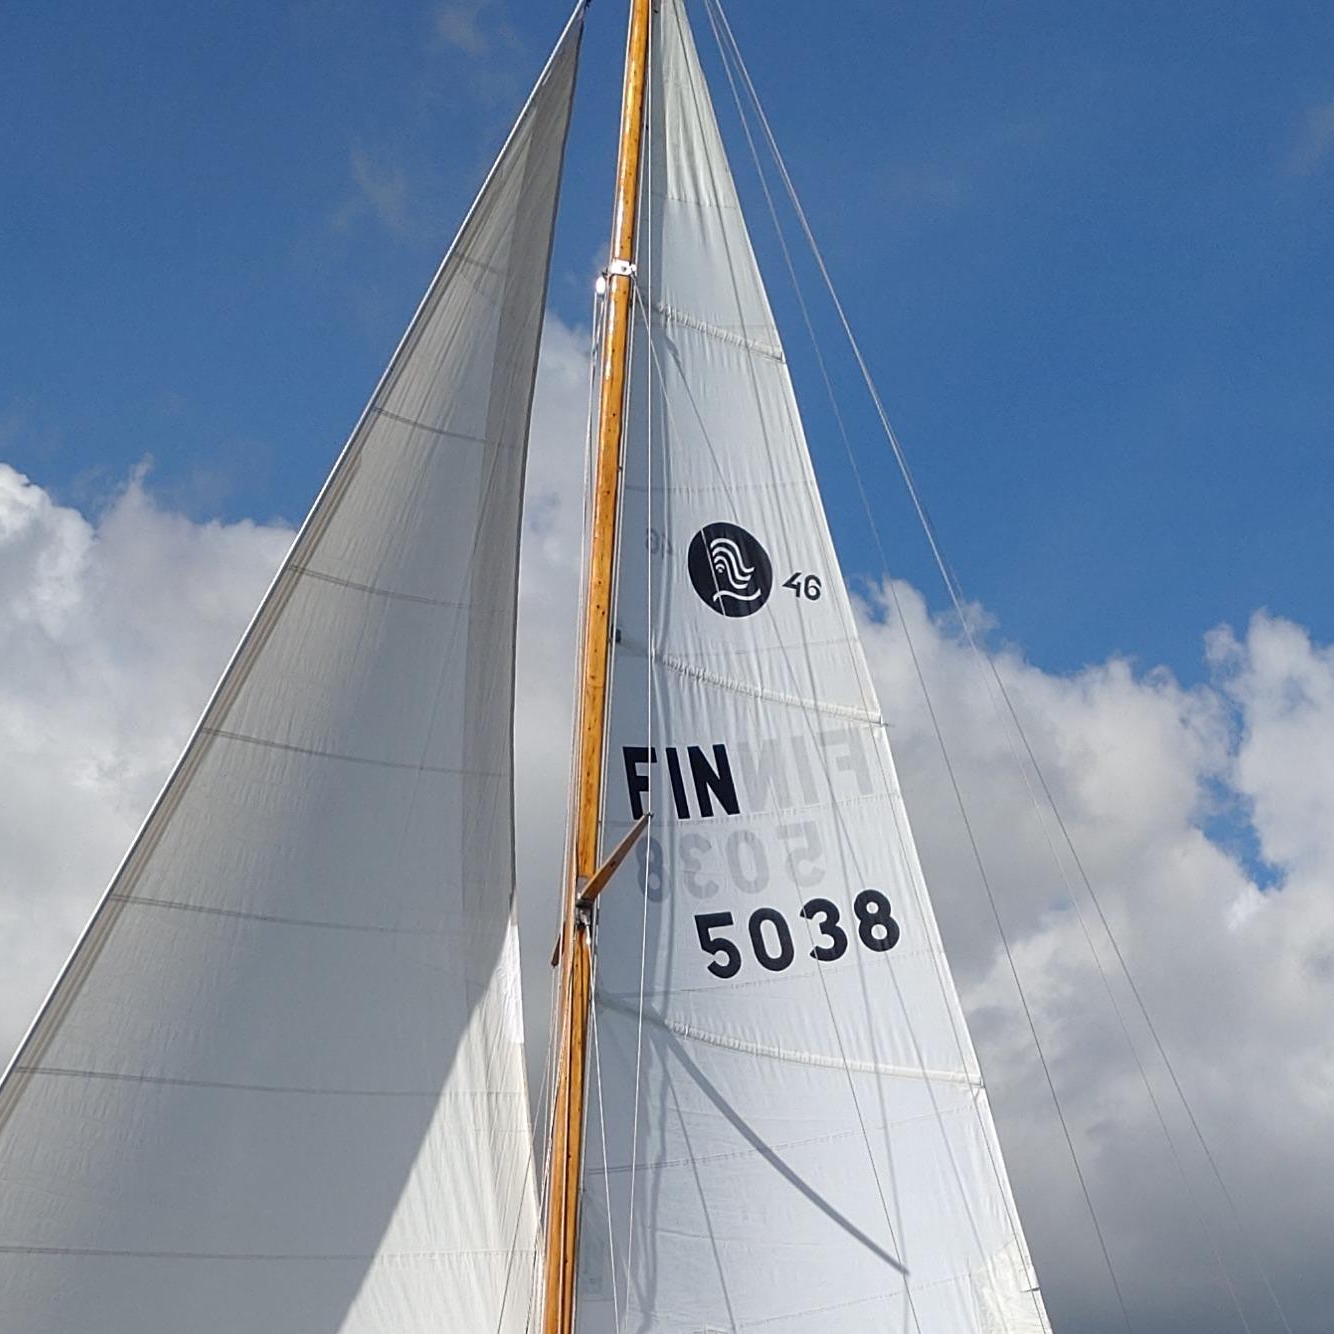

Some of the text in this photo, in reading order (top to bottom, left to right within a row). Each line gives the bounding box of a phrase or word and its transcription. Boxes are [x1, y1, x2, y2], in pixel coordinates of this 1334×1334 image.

[781, 571, 823, 601] 46
[622, 743, 741, 820] FIN
[693, 888, 901, 979] 5038
